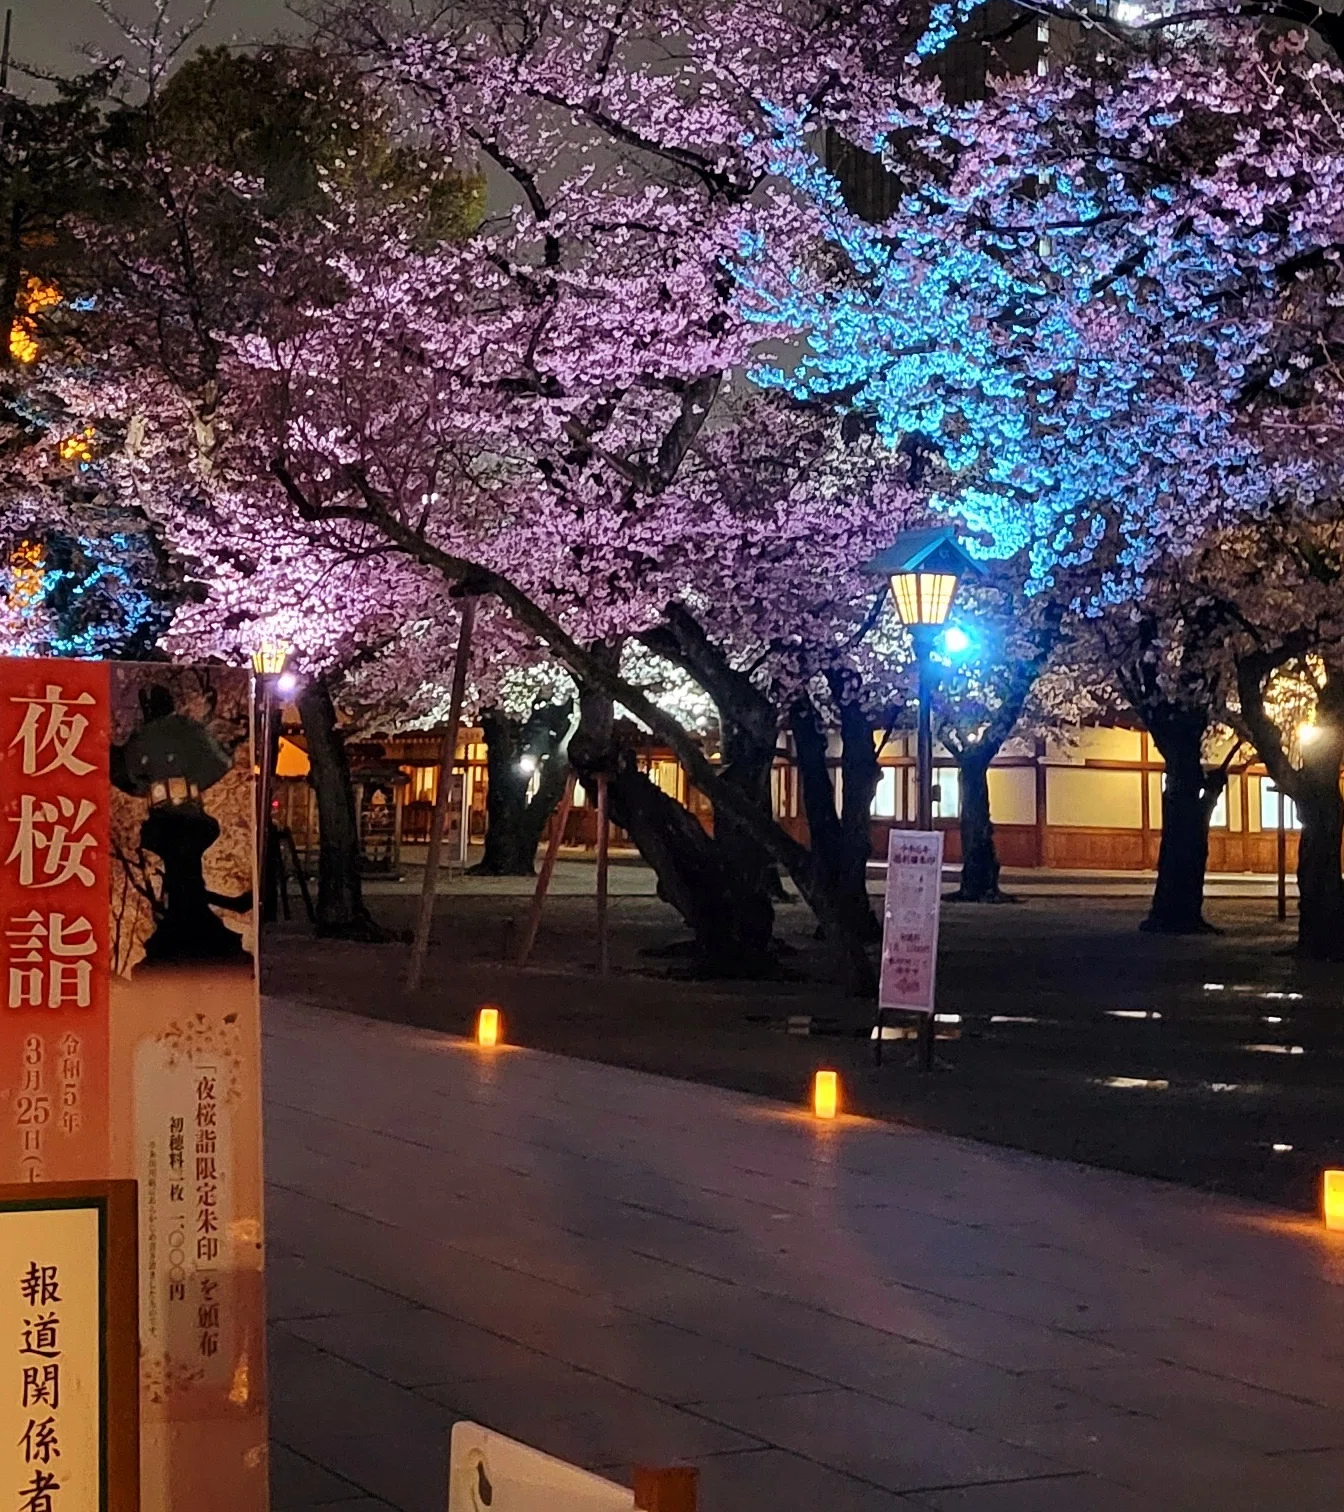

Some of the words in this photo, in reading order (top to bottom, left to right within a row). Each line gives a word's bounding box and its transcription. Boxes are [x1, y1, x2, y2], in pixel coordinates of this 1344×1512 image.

[5, 685, 99, 1009] 夜桜詣
[62, 1033, 81, 1133] 令和5年
[17, 1261, 62, 1512] 報道関係者
